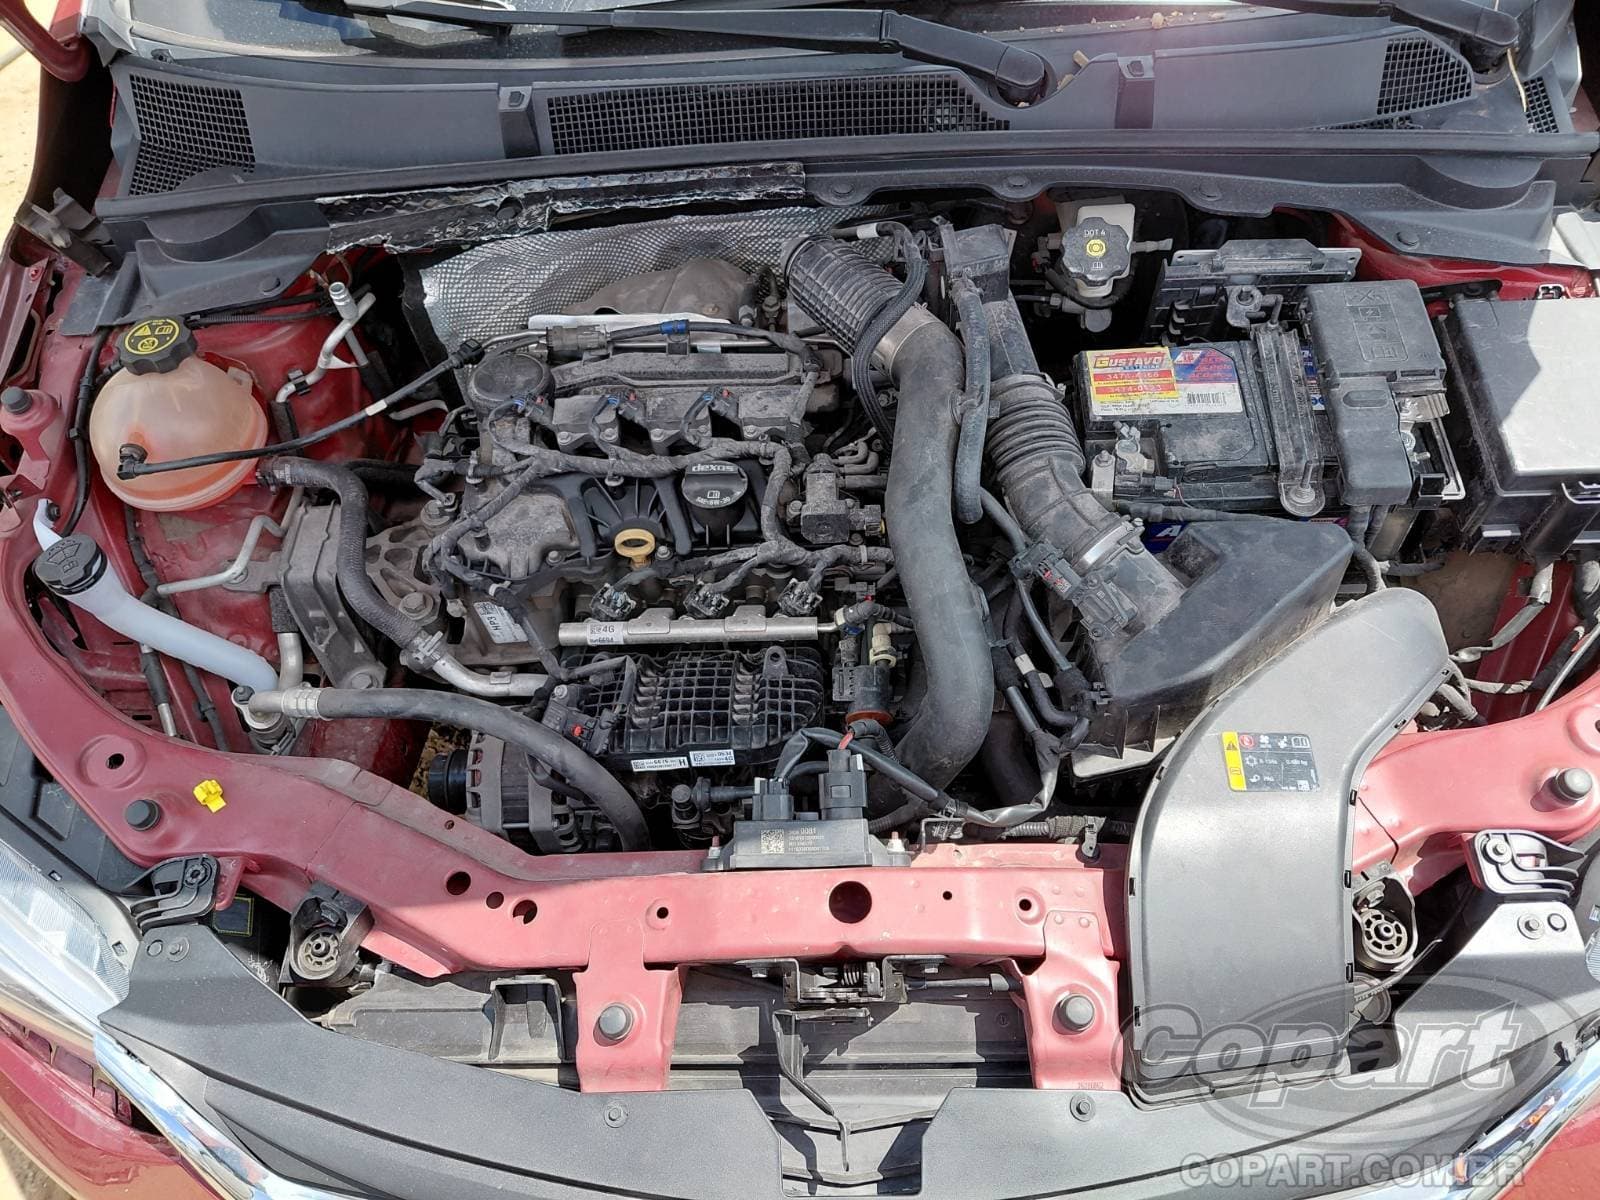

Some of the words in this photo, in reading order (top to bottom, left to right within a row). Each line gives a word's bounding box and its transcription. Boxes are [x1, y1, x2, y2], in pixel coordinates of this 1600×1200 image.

[692, 464, 735, 472] dexos
[486, 616, 502, 631] HP3
[602, 624, 615, 633] 4G
